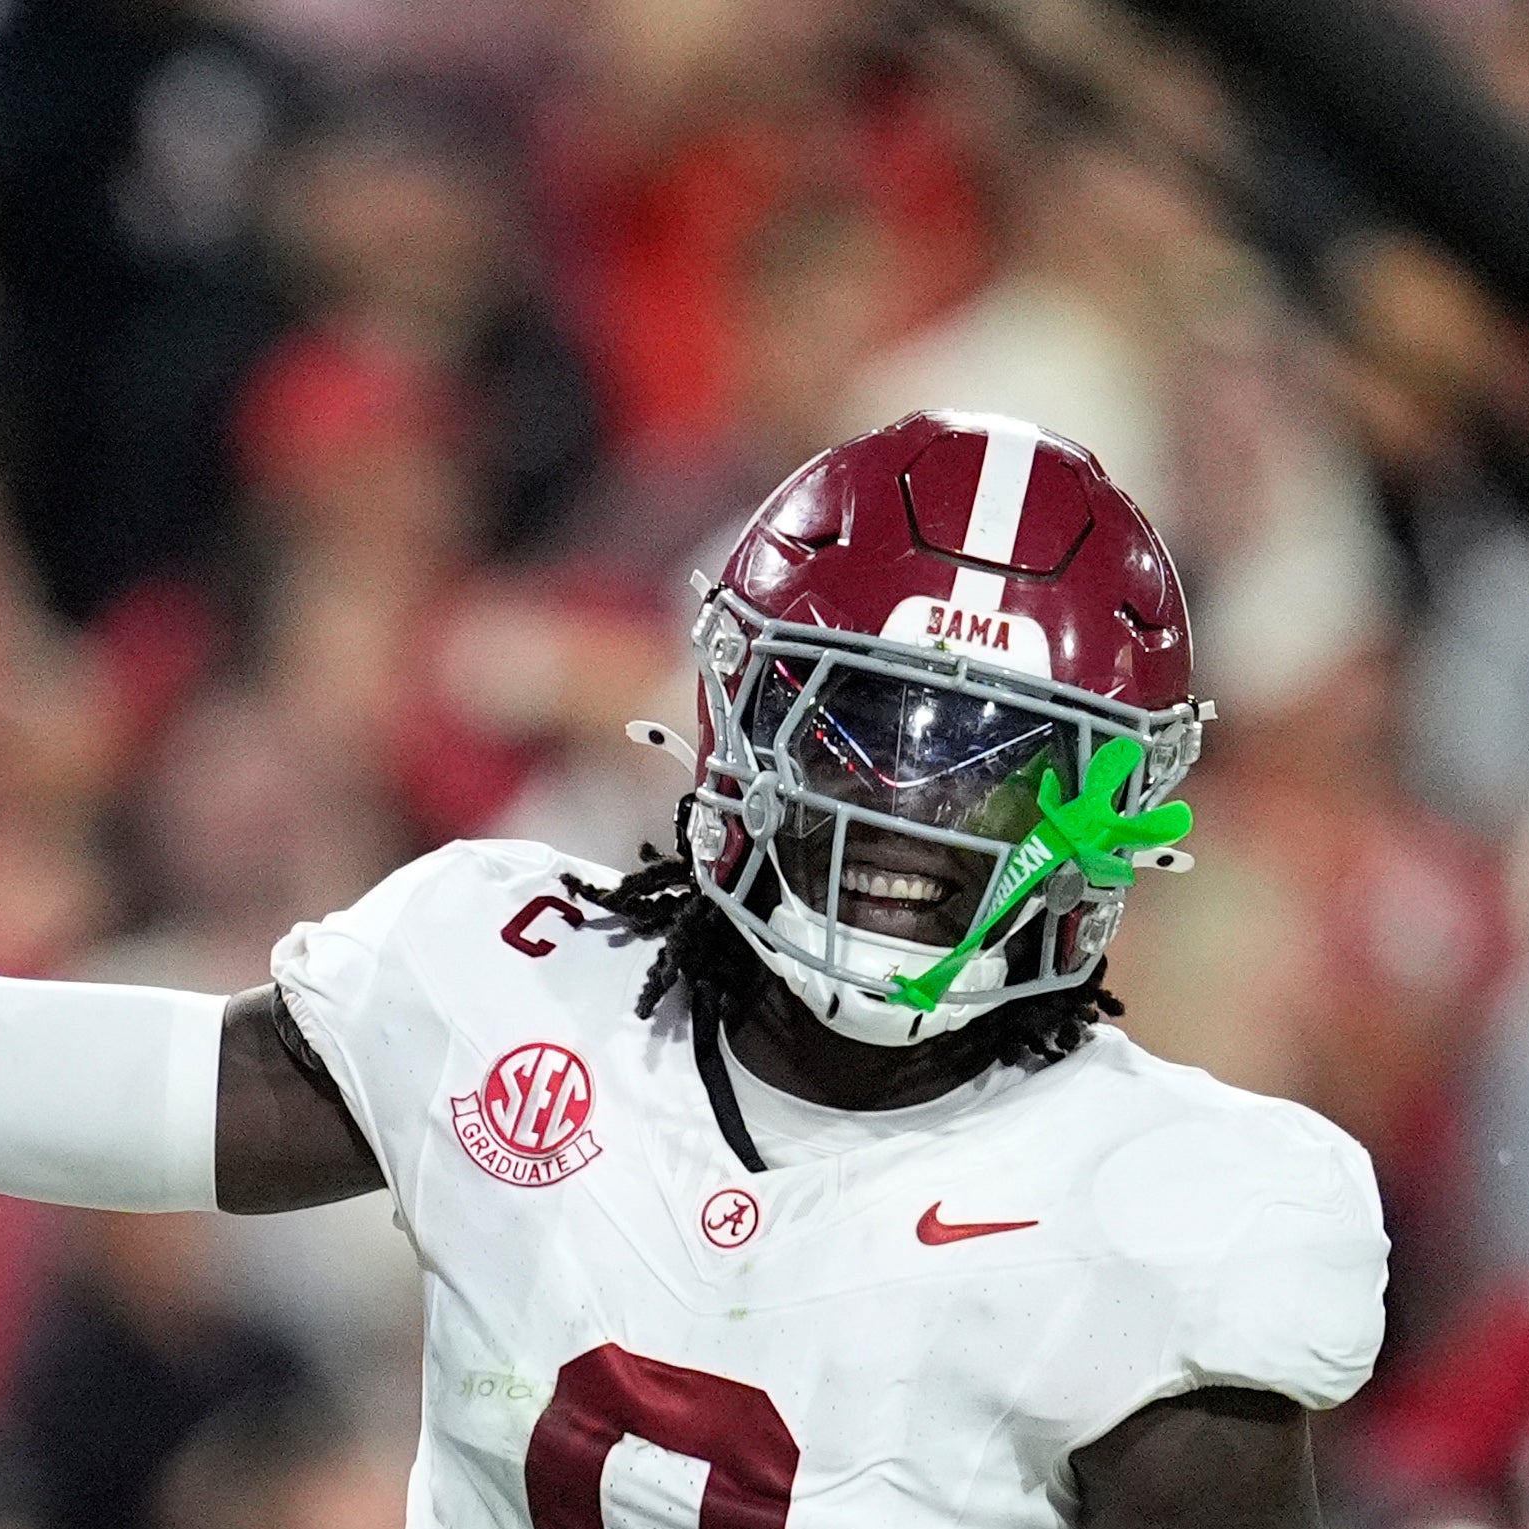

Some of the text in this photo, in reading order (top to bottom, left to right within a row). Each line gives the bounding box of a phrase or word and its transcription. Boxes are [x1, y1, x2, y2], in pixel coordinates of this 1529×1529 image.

[925, 605, 1011, 652] BAMA
[987, 834, 1054, 916] NXTR
[489, 1045, 588, 1150] SEC
[462, 1121, 571, 1183] GRADUATE
[706, 1198, 751, 1237] A
